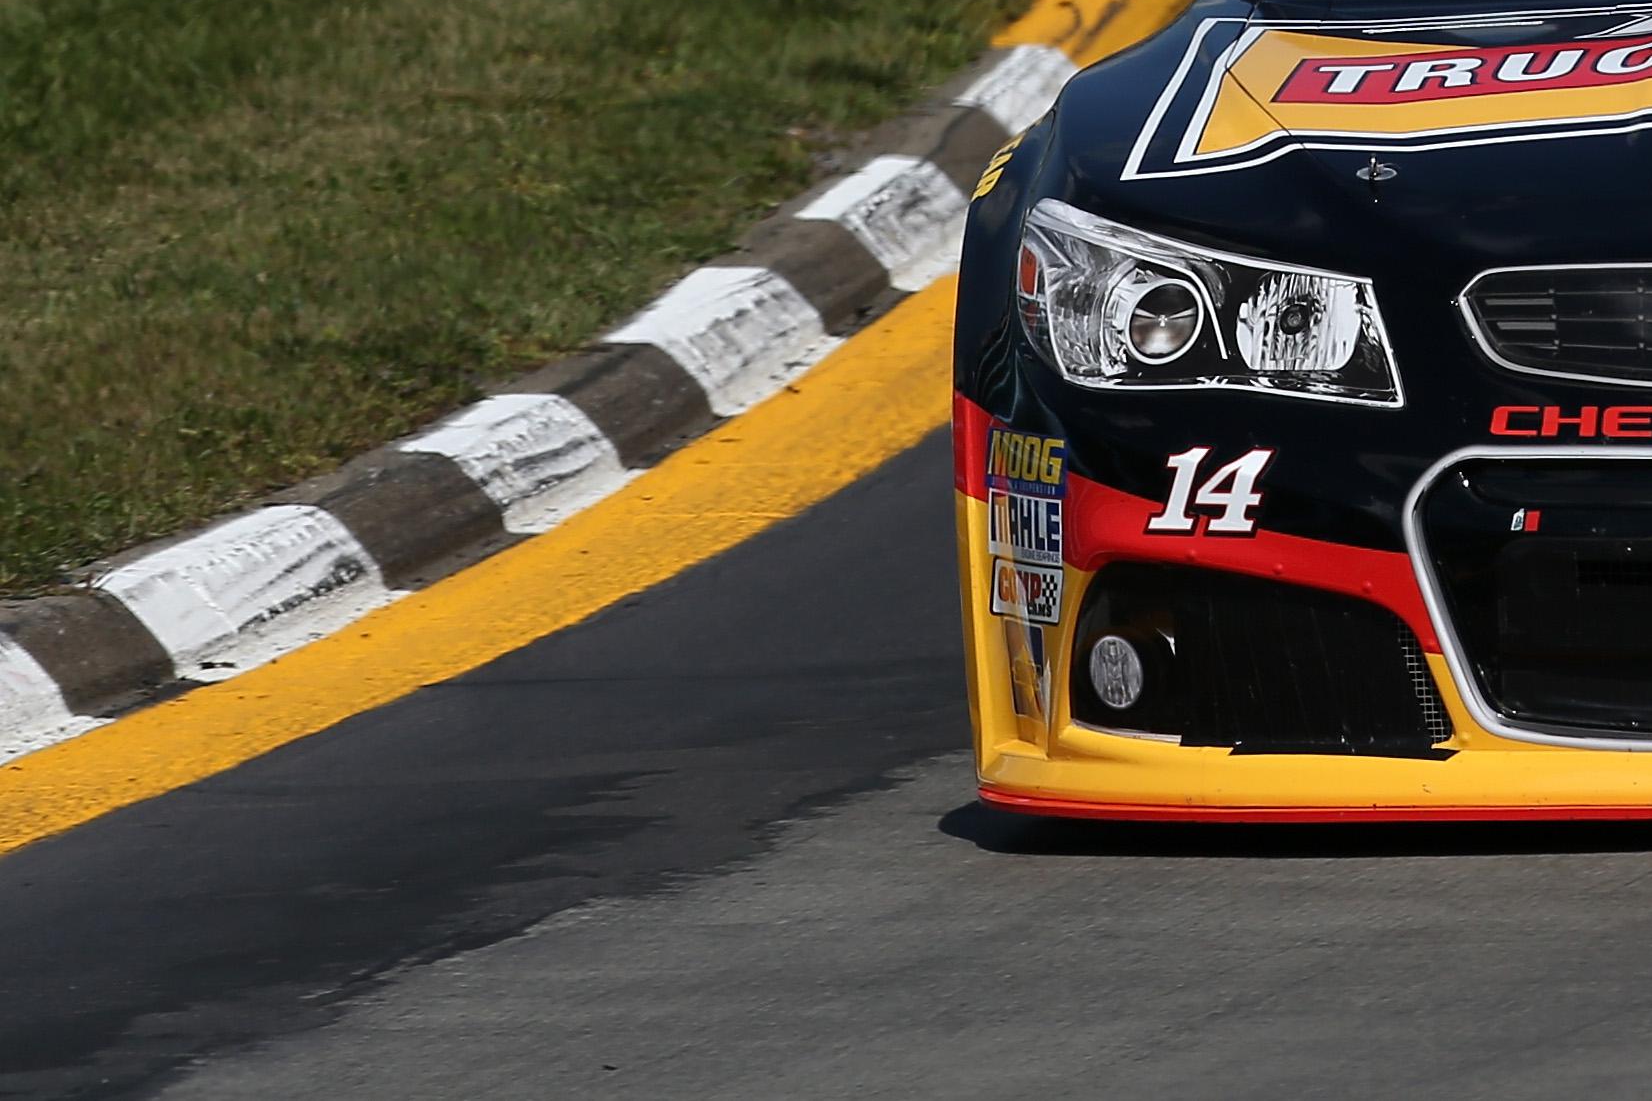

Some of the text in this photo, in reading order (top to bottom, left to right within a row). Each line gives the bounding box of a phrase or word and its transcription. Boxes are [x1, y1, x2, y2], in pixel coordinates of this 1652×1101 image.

[988, 430, 1064, 485] MOOG
[1145, 446, 1276, 536] 14
[990, 491, 1060, 552] MAHLE
[998, 565, 1042, 602] COMP
[1026, 598, 1053, 617] CAMS
